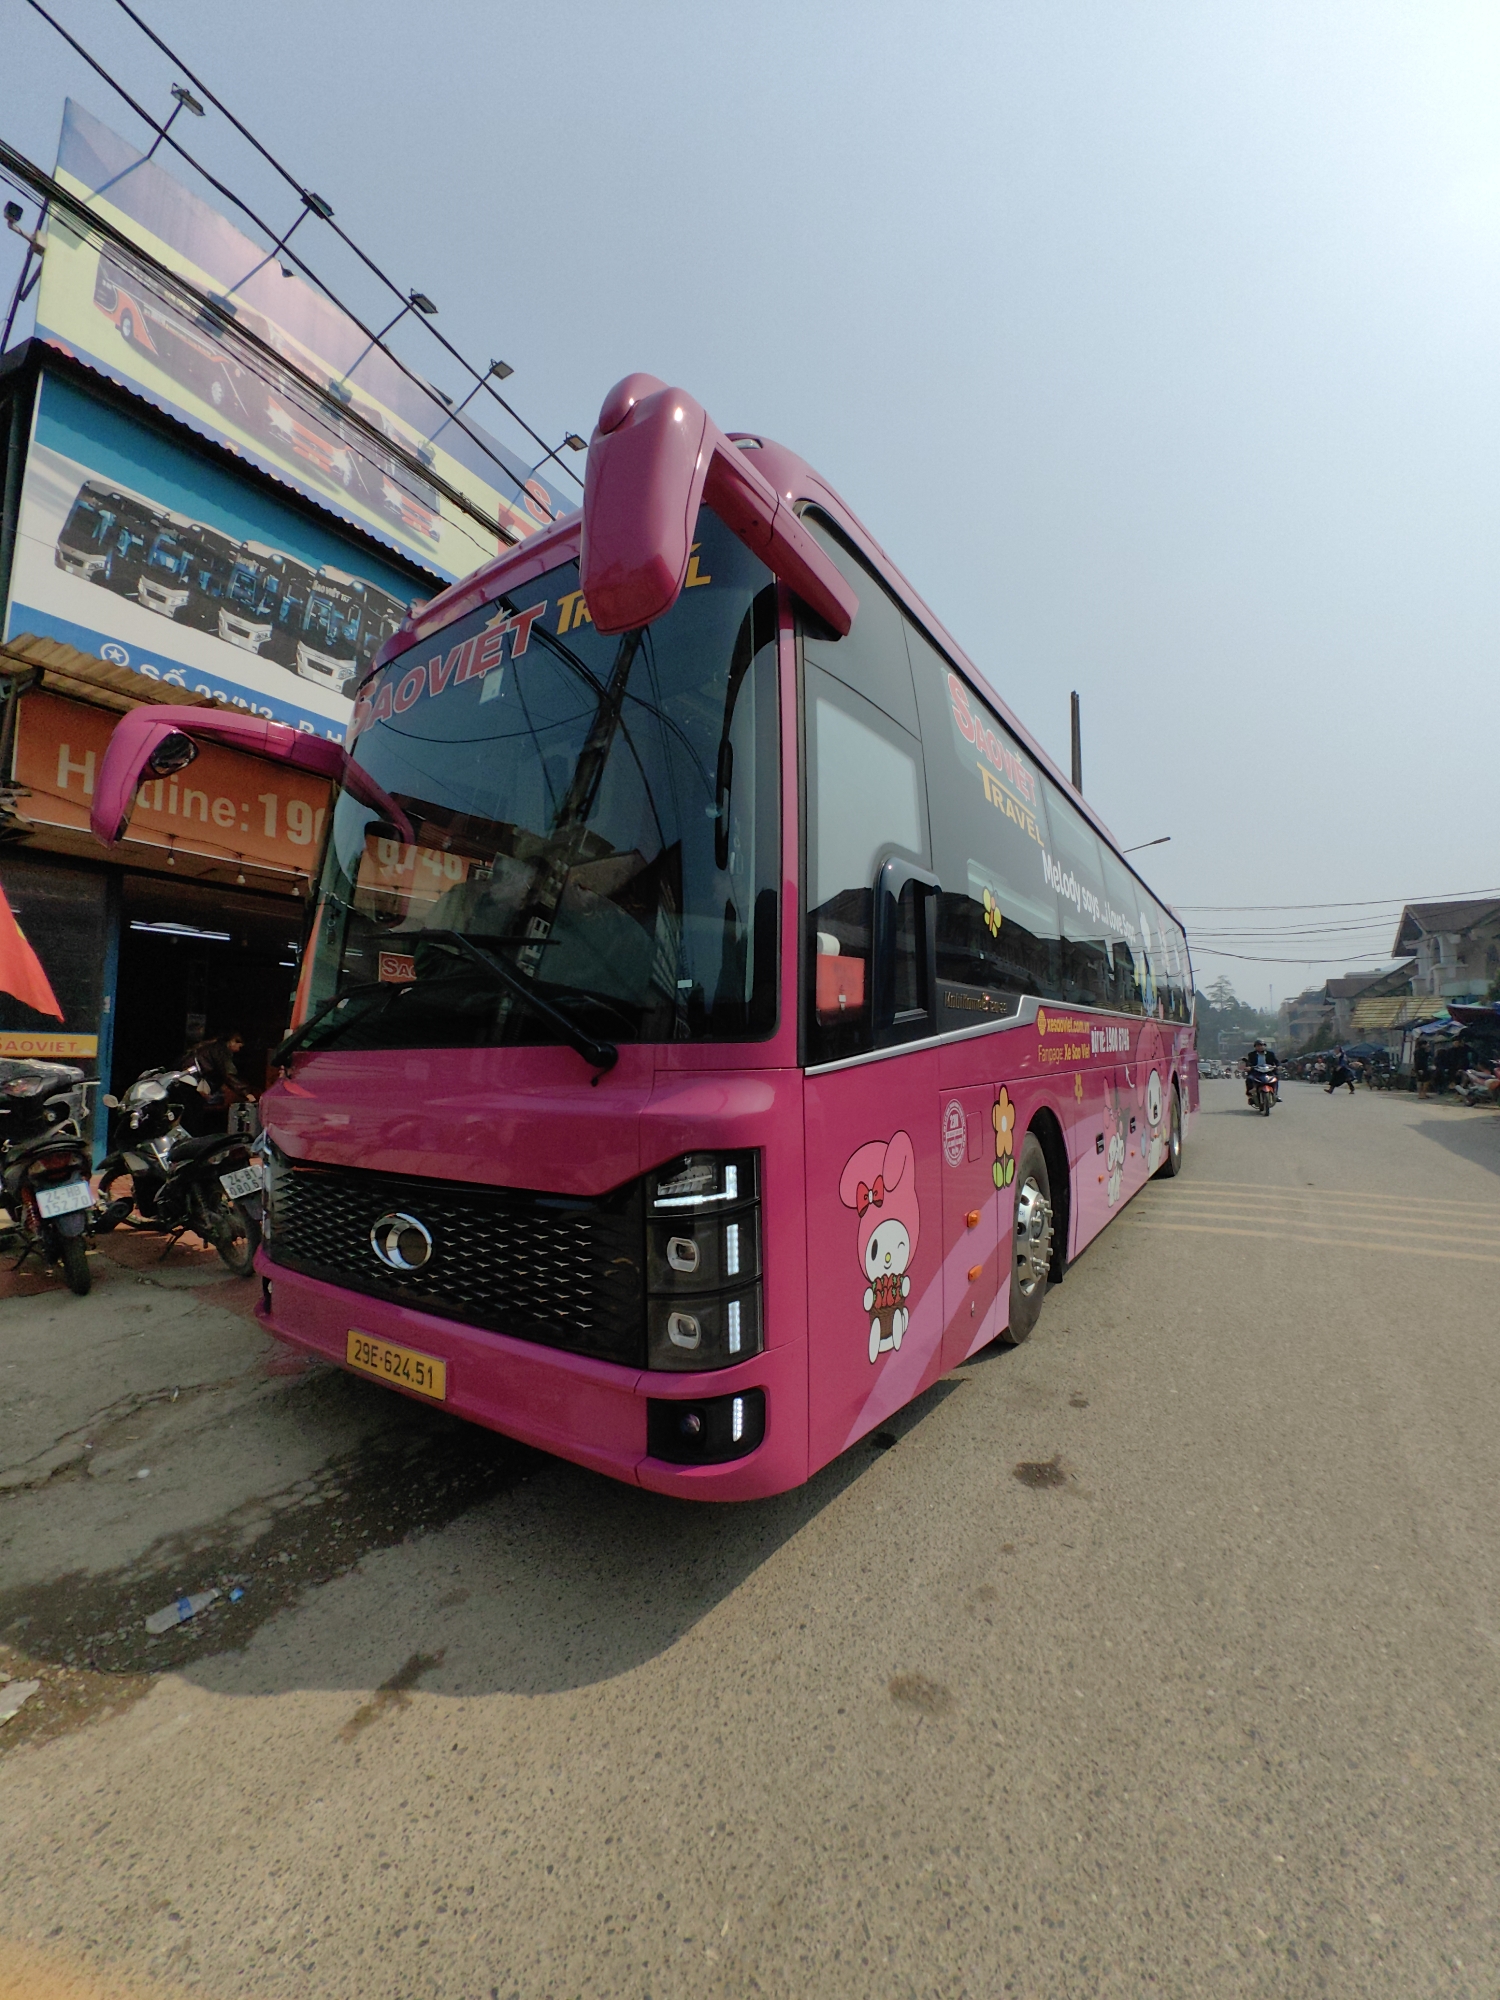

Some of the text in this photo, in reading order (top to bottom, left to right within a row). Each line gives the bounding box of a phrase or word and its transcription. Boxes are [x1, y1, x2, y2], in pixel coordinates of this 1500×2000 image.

[57, 743, 249, 832] Htline:
[976, 761, 1045, 848] TRAVEL
[1041, 849, 1081, 914] Melody
[1081, 886, 1100, 923] says
[354, 1339, 434, 1389] 29E-624.51
